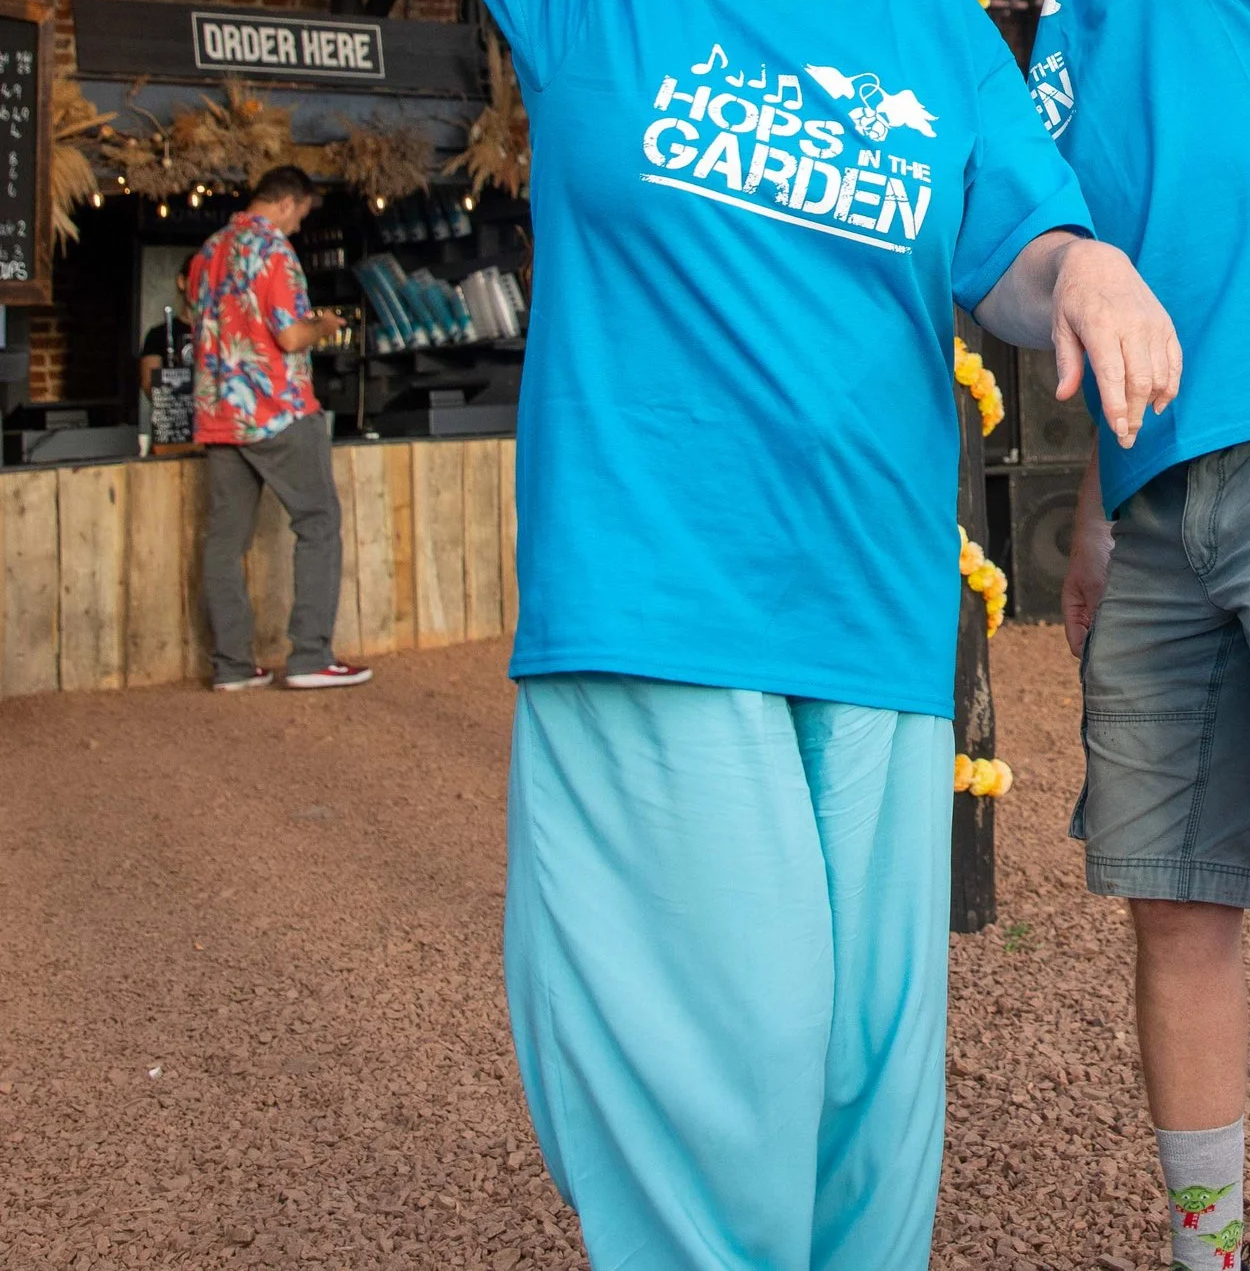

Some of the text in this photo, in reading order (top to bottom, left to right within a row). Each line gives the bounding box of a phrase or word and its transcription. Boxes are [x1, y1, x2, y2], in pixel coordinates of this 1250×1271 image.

[202, 22, 374, 70] ORDER HERE
[1030, 51, 1065, 82] THE
[653, 74, 846, 159] HOPS
[643, 117, 932, 240] GARDEN
[857, 149, 932, 184] IN THE
